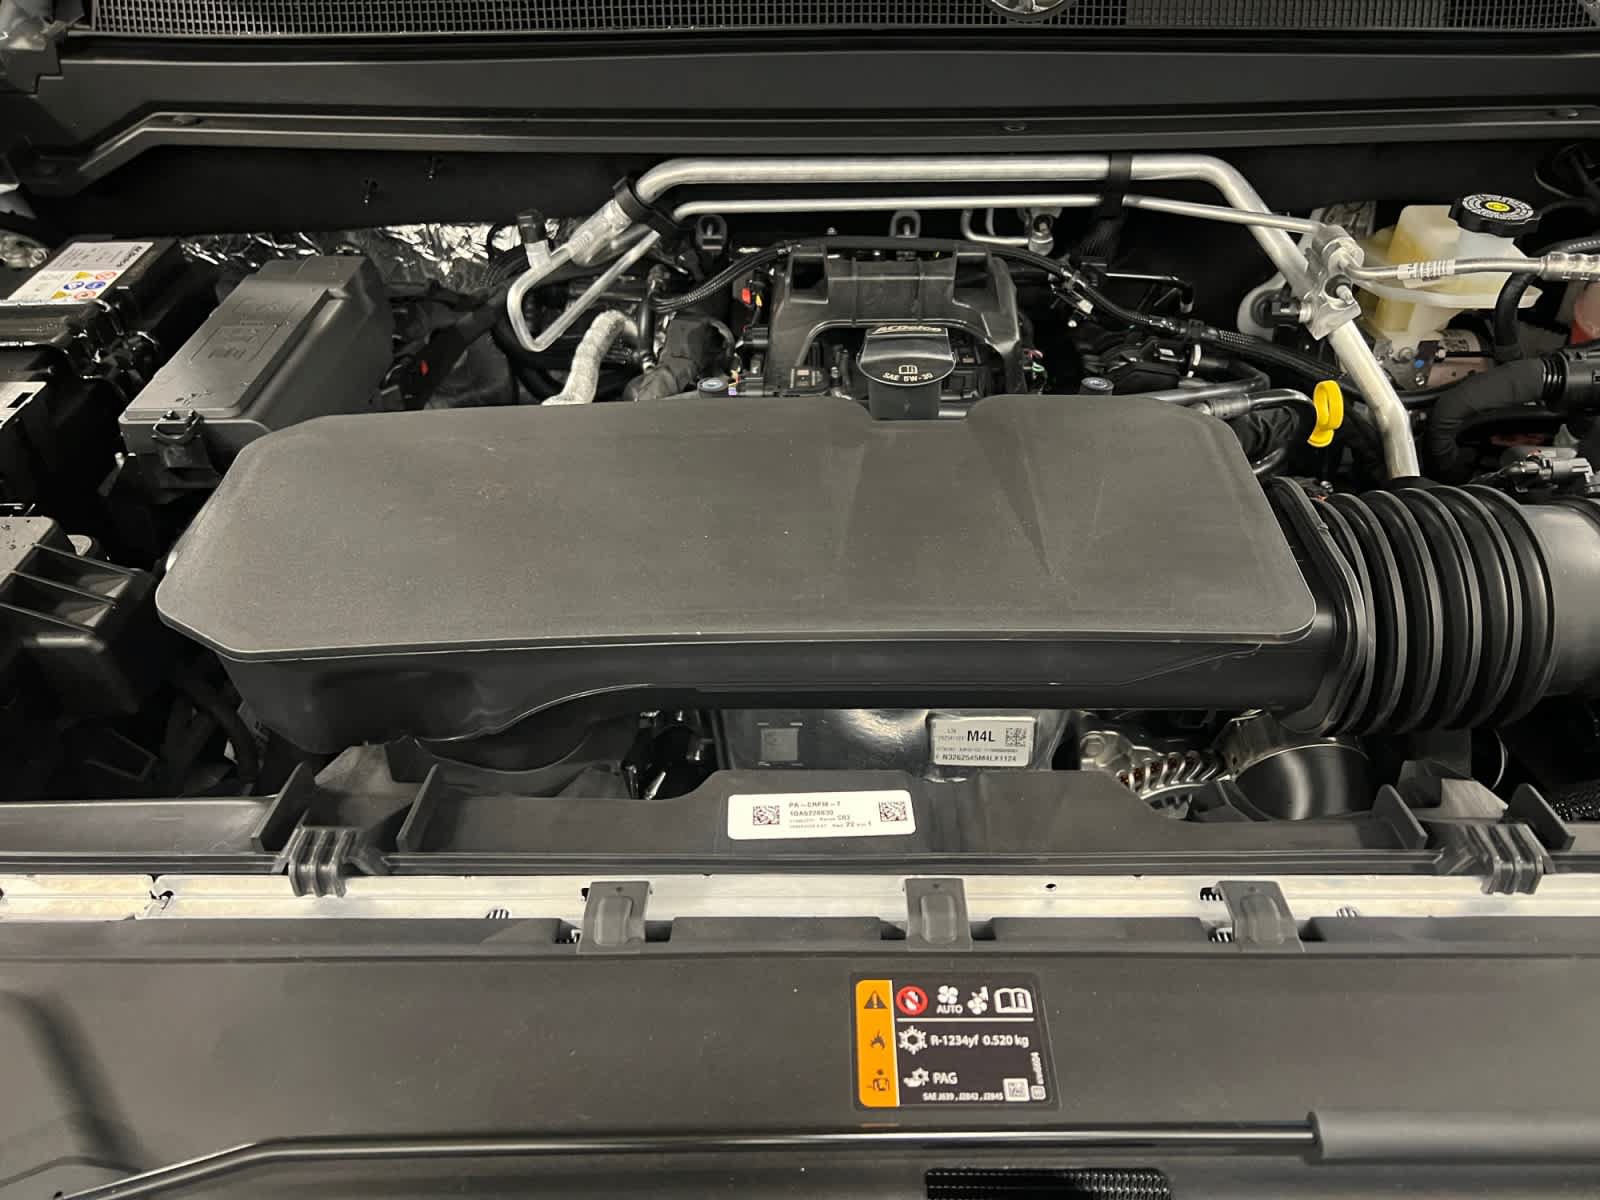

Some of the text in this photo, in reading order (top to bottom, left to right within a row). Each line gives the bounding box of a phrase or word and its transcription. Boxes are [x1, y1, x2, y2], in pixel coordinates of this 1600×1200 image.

[882, 372, 934, 382] SAE 5W-30
[967, 730, 996, 742] M4L
[936, 1004, 963, 1014] AUTO
[930, 1034, 1030, 1048] R-1234yf 0.520 kg
[932, 1072, 958, 1084] PAG
